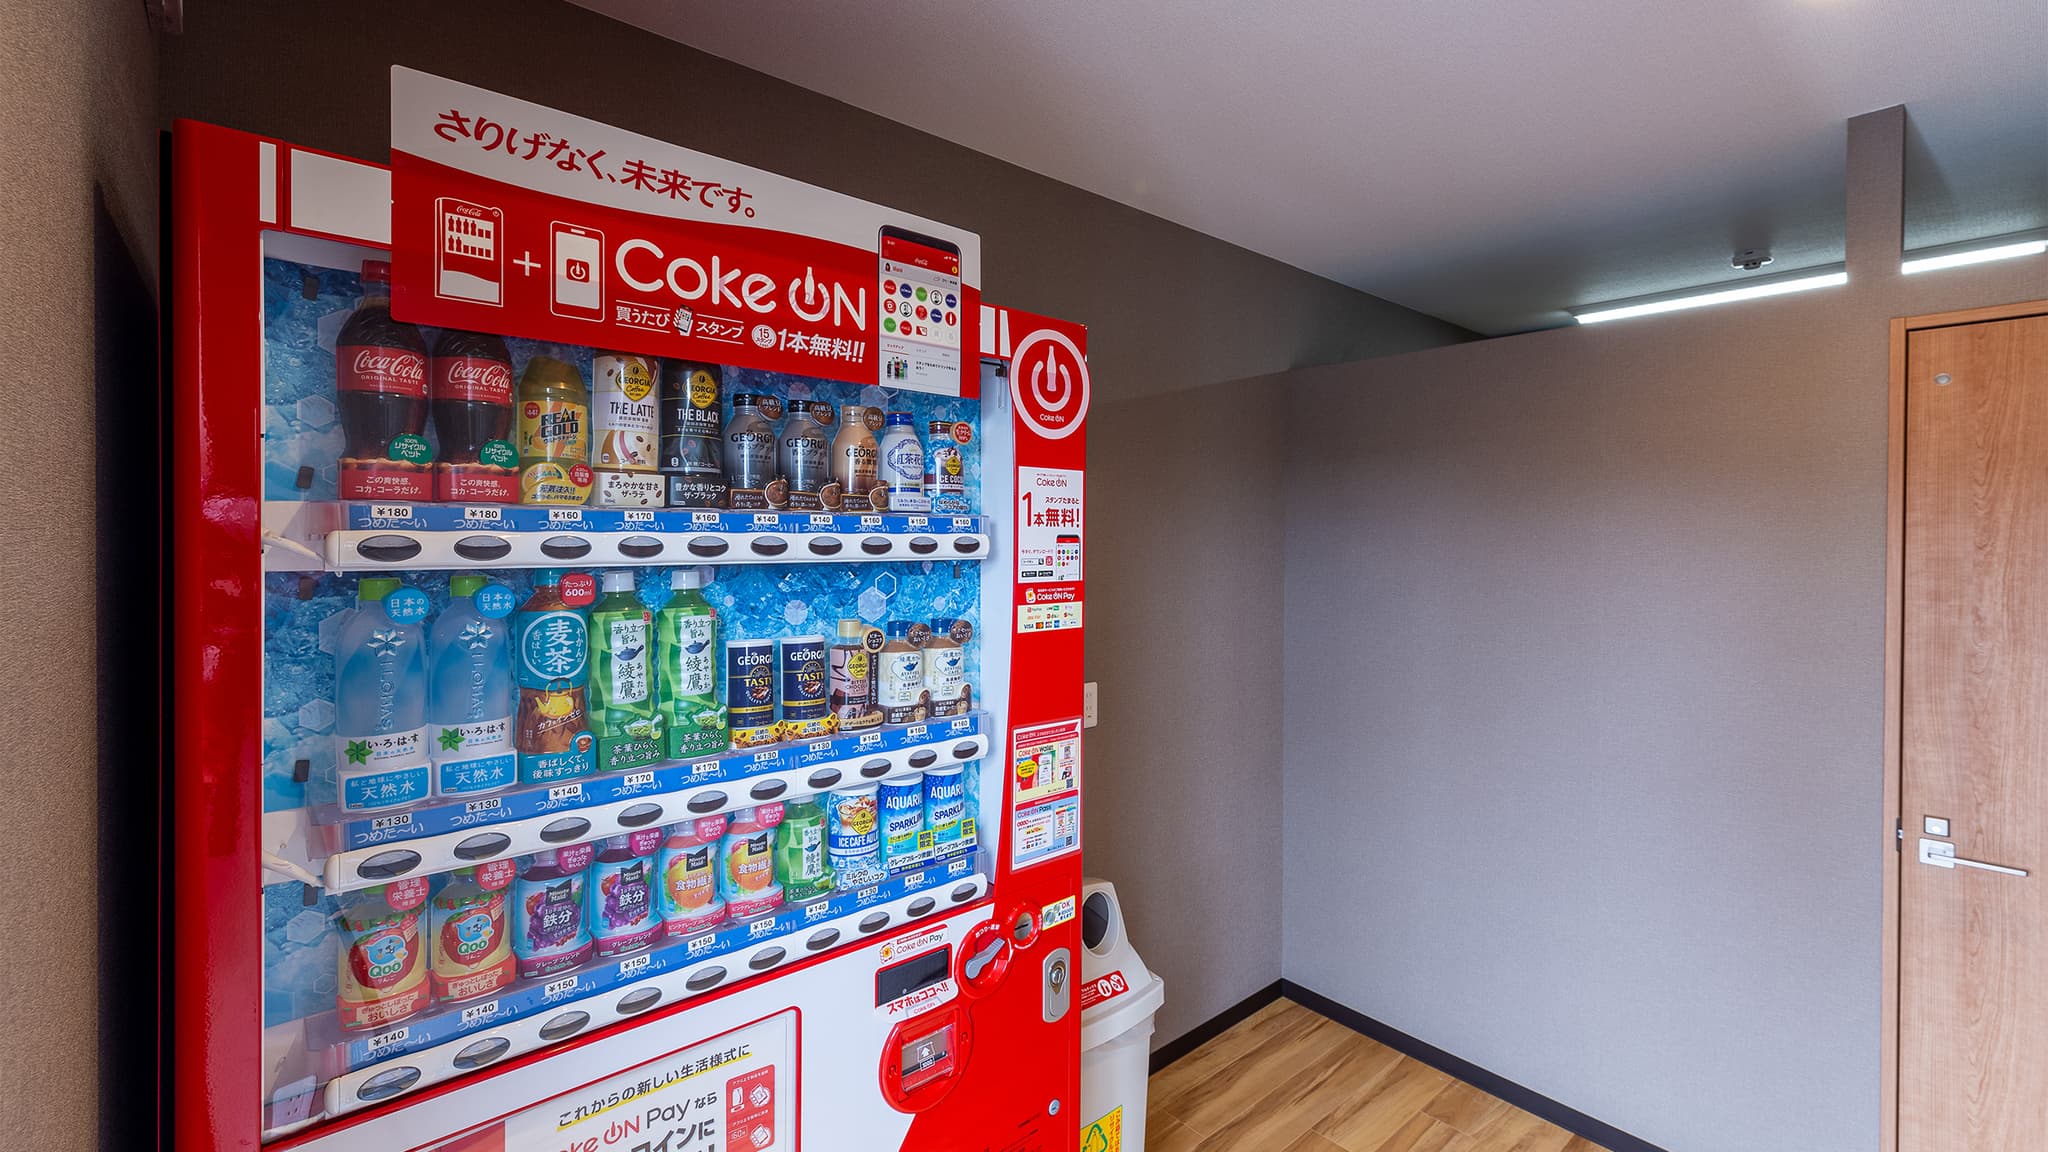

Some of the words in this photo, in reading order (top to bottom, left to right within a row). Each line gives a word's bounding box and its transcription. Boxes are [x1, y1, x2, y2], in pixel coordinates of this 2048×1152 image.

[433, 109, 755, 218] さりげなく、未来です。
[615, 239, 776, 313] Coke
[788, 266, 866, 331] ON
[616, 305, 670, 327] 買うたび
[696, 320, 744, 339] スタンプ
[758, 328, 770, 338] 15
[777, 329, 866, 363] 1本無料!!
[354, 350, 424, 380] Coca-Cola
[361, 374, 396, 383] ORIGINAL
[448, 361, 510, 389] Coca-Cola
[610, 402, 629, 415] THE
[631, 404, 654, 418] LATTE
[677, 408, 694, 420] THE
[541, 408, 578, 426] REAL
[541, 422, 578, 438] GOLD
[394, 442, 426, 451] リサイクル
[485, 448, 513, 456] リサイクル
[366, 475, 411, 486] この爽快感。
[608, 481, 659, 491] まろやかな甘さ
[1037, 477, 1055, 487] Coke
[1055, 478, 1067, 488] ON
[355, 485, 421, 495] コカ・コーラだけ。
[675, 482, 727, 492] 豊かな香りとコク
[621, 490, 645, 498] ザ・ラテ
[684, 491, 717, 500] ザ・ブラック
[376, 507, 408, 517] ¥180
[469, 509, 498, 519] ¥180
[553, 511, 578, 520] ¥160
[1022, 491, 1080, 528] 1本無料!
[627, 512, 652, 521] ¥170
[695, 514, 717, 522] ¥160
[756, 515, 777, 523] ¥140
[812, 516, 831, 524] ¥140
[564, 579, 592, 588] たっぷり
[482, 592, 511, 602] 日本の
[565, 588, 592, 597] 600ml
[391, 597, 424, 609] 日本の
[482, 600, 512, 611] 天然水
[391, 607, 425, 617] 天然水
[613, 624, 645, 635] 香り立つ
[684, 619, 711, 629] 香り立つ
[621, 634, 638, 644] 旨み
[690, 629, 705, 639] 旨み
[531, 629, 542, 665] 香ばしい
[543, 619, 575, 673] 麦茶
[685, 656, 703, 691] 綾鷹
[703, 656, 711, 690] あやたか
[618, 662, 637, 700] 綾鷹
[636, 663, 645, 697] あやたか
[537, 710, 582, 730] カフェインゼロ
[460, 722, 505, 737] い・ろ・は・す
[367, 733, 419, 749] い・ろ・は・す
[683, 732, 723, 743] 茶葉ひらく、
[862, 735, 879, 743] ¥140
[613, 742, 657, 754] 茶葉ひらく、
[680, 740, 725, 754] 香り立つ旨み
[812, 742, 830, 751] ¥130
[537, 754, 585, 769] 香ばしくて、
[609, 750, 660, 766] 香り立つ旨み
[756, 752, 777, 761] ¥130
[532, 762, 589, 780] 後味すっきり
[695, 762, 718, 771] ¥170
[455, 766, 504, 785] 天然水
[626, 774, 651, 783] ¥170
[361, 780, 415, 801] 天然水
[553, 786, 578, 797] ¥140
[469, 800, 499, 811] ¥130
[375, 816, 409, 827] ¥130
[838, 837, 849, 847] ICE
[482, 869, 513, 883] 栄養士
[846, 869, 868, 880] ミルクの
[852, 872, 885, 885] やさしいコク
[392, 887, 425, 901] 栄養士
[619, 890, 645, 908] 鉄分
[808, 904, 827, 914] ¥140
[543, 910, 573, 928] 鉄分
[753, 920, 773, 930] ¥150
[457, 939, 488, 955] Qoo
[691, 937, 713, 948] ¥150
[896, 942, 916, 954] Coke
[917, 938, 928, 948] ON
[929, 933, 944, 942] Pay
[623, 957, 647, 969] ¥150
[369, 961, 402, 978] Qoo
[458, 980, 494, 996] おいしさ
[548, 979, 574, 992] ¥150
[886, 982, 949, 1015] スマホはココへ!!
[367, 1003, 409, 1022] おいしさ
[466, 1004, 495, 1018] ¥140
[372, 1030, 405, 1047] ¥140
[559, 1043, 751, 1127] これからの新しい生活様式に
[603, 1115, 640, 1145] ON
[647, 1098, 691, 1129] Pay
[694, 1091, 717, 1110] なら
